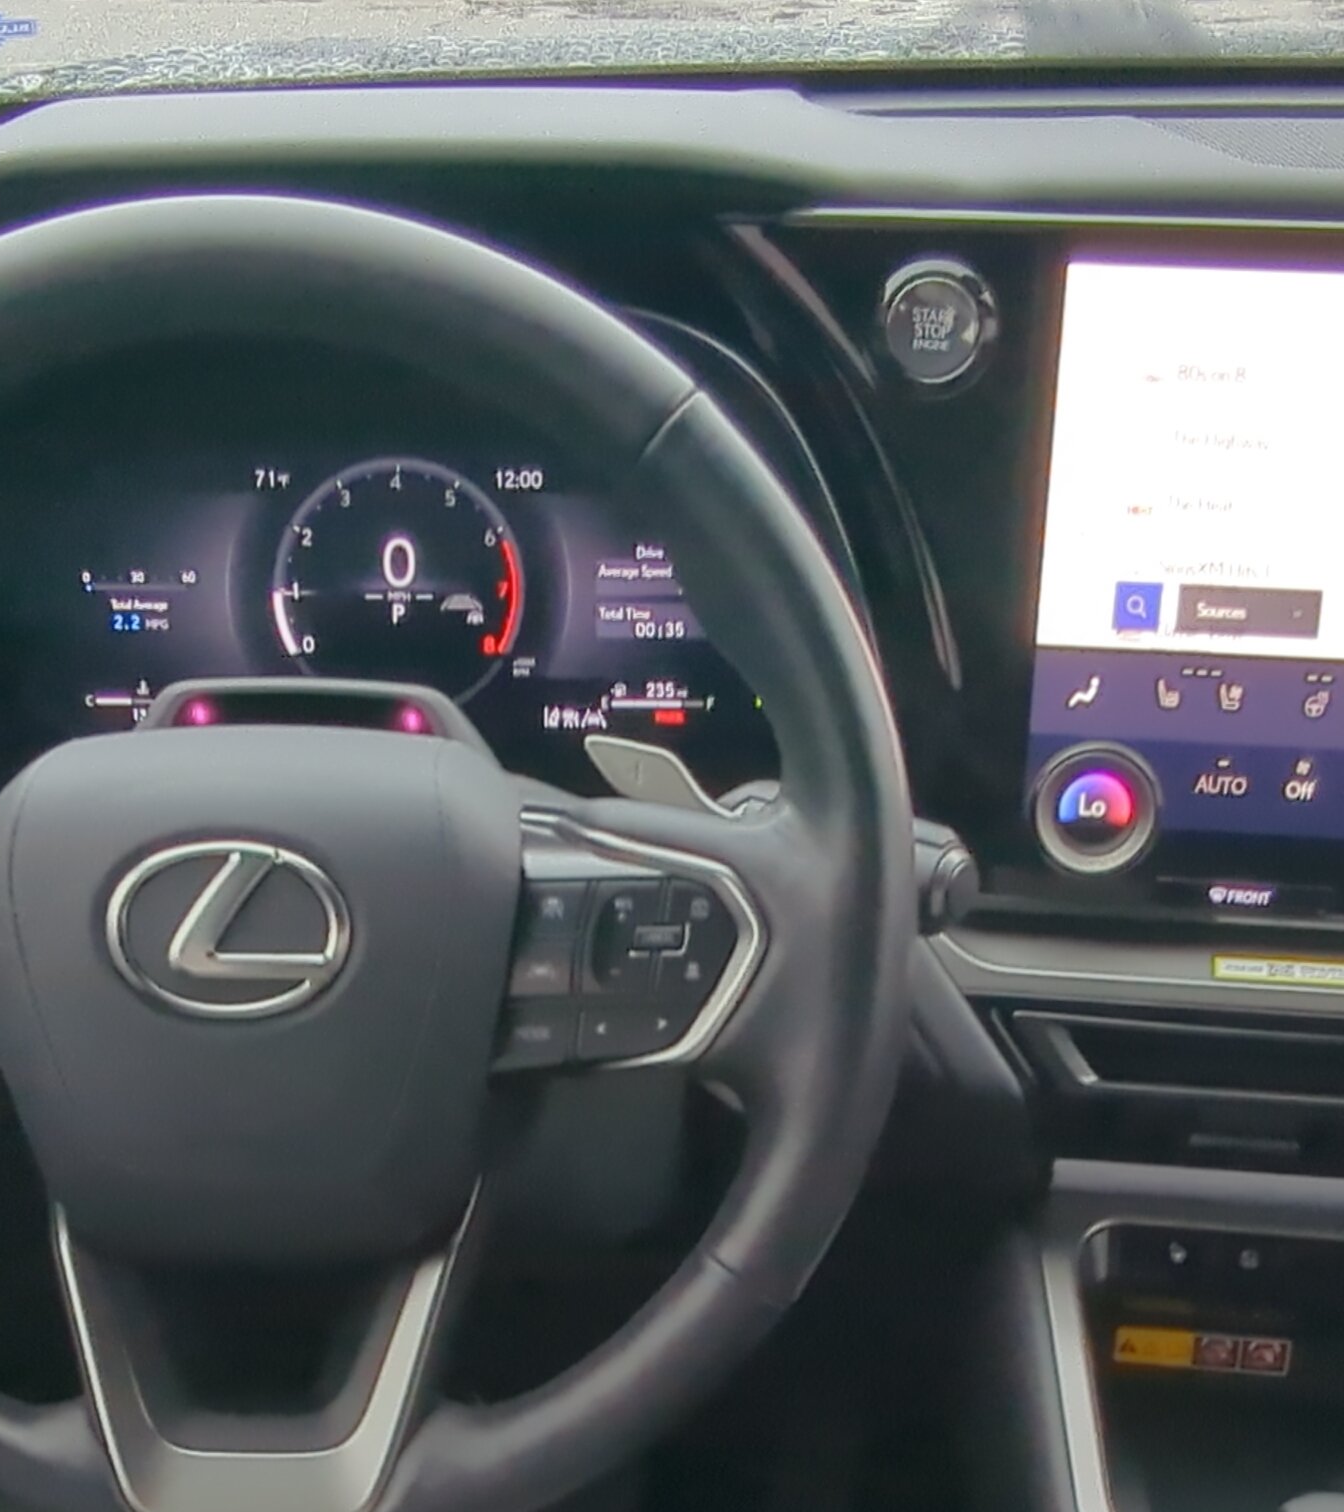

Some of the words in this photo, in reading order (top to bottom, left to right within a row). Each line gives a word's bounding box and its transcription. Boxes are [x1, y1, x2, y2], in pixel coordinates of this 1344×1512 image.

[390, 474, 402, 491] 4
[495, 470, 544, 489] 12:00
[340, 490, 351, 507] 3
[444, 490, 456, 507] 5
[301, 528, 313, 547] 2
[484, 529, 497, 547] 6
[382, 537, 416, 588] 0
[393, 603, 406, 624] P
[1197, 602, 1247, 620] Sources
[113, 614, 141, 631] 2.2
[302, 636, 316, 654] 0
[645, 682, 675, 698] 235
[1194, 776, 1248, 796] AUTO
[1284, 780, 1317, 801] Off
[1078, 792, 1106, 818] Lo
[1227, 889, 1273, 907] FRONT
